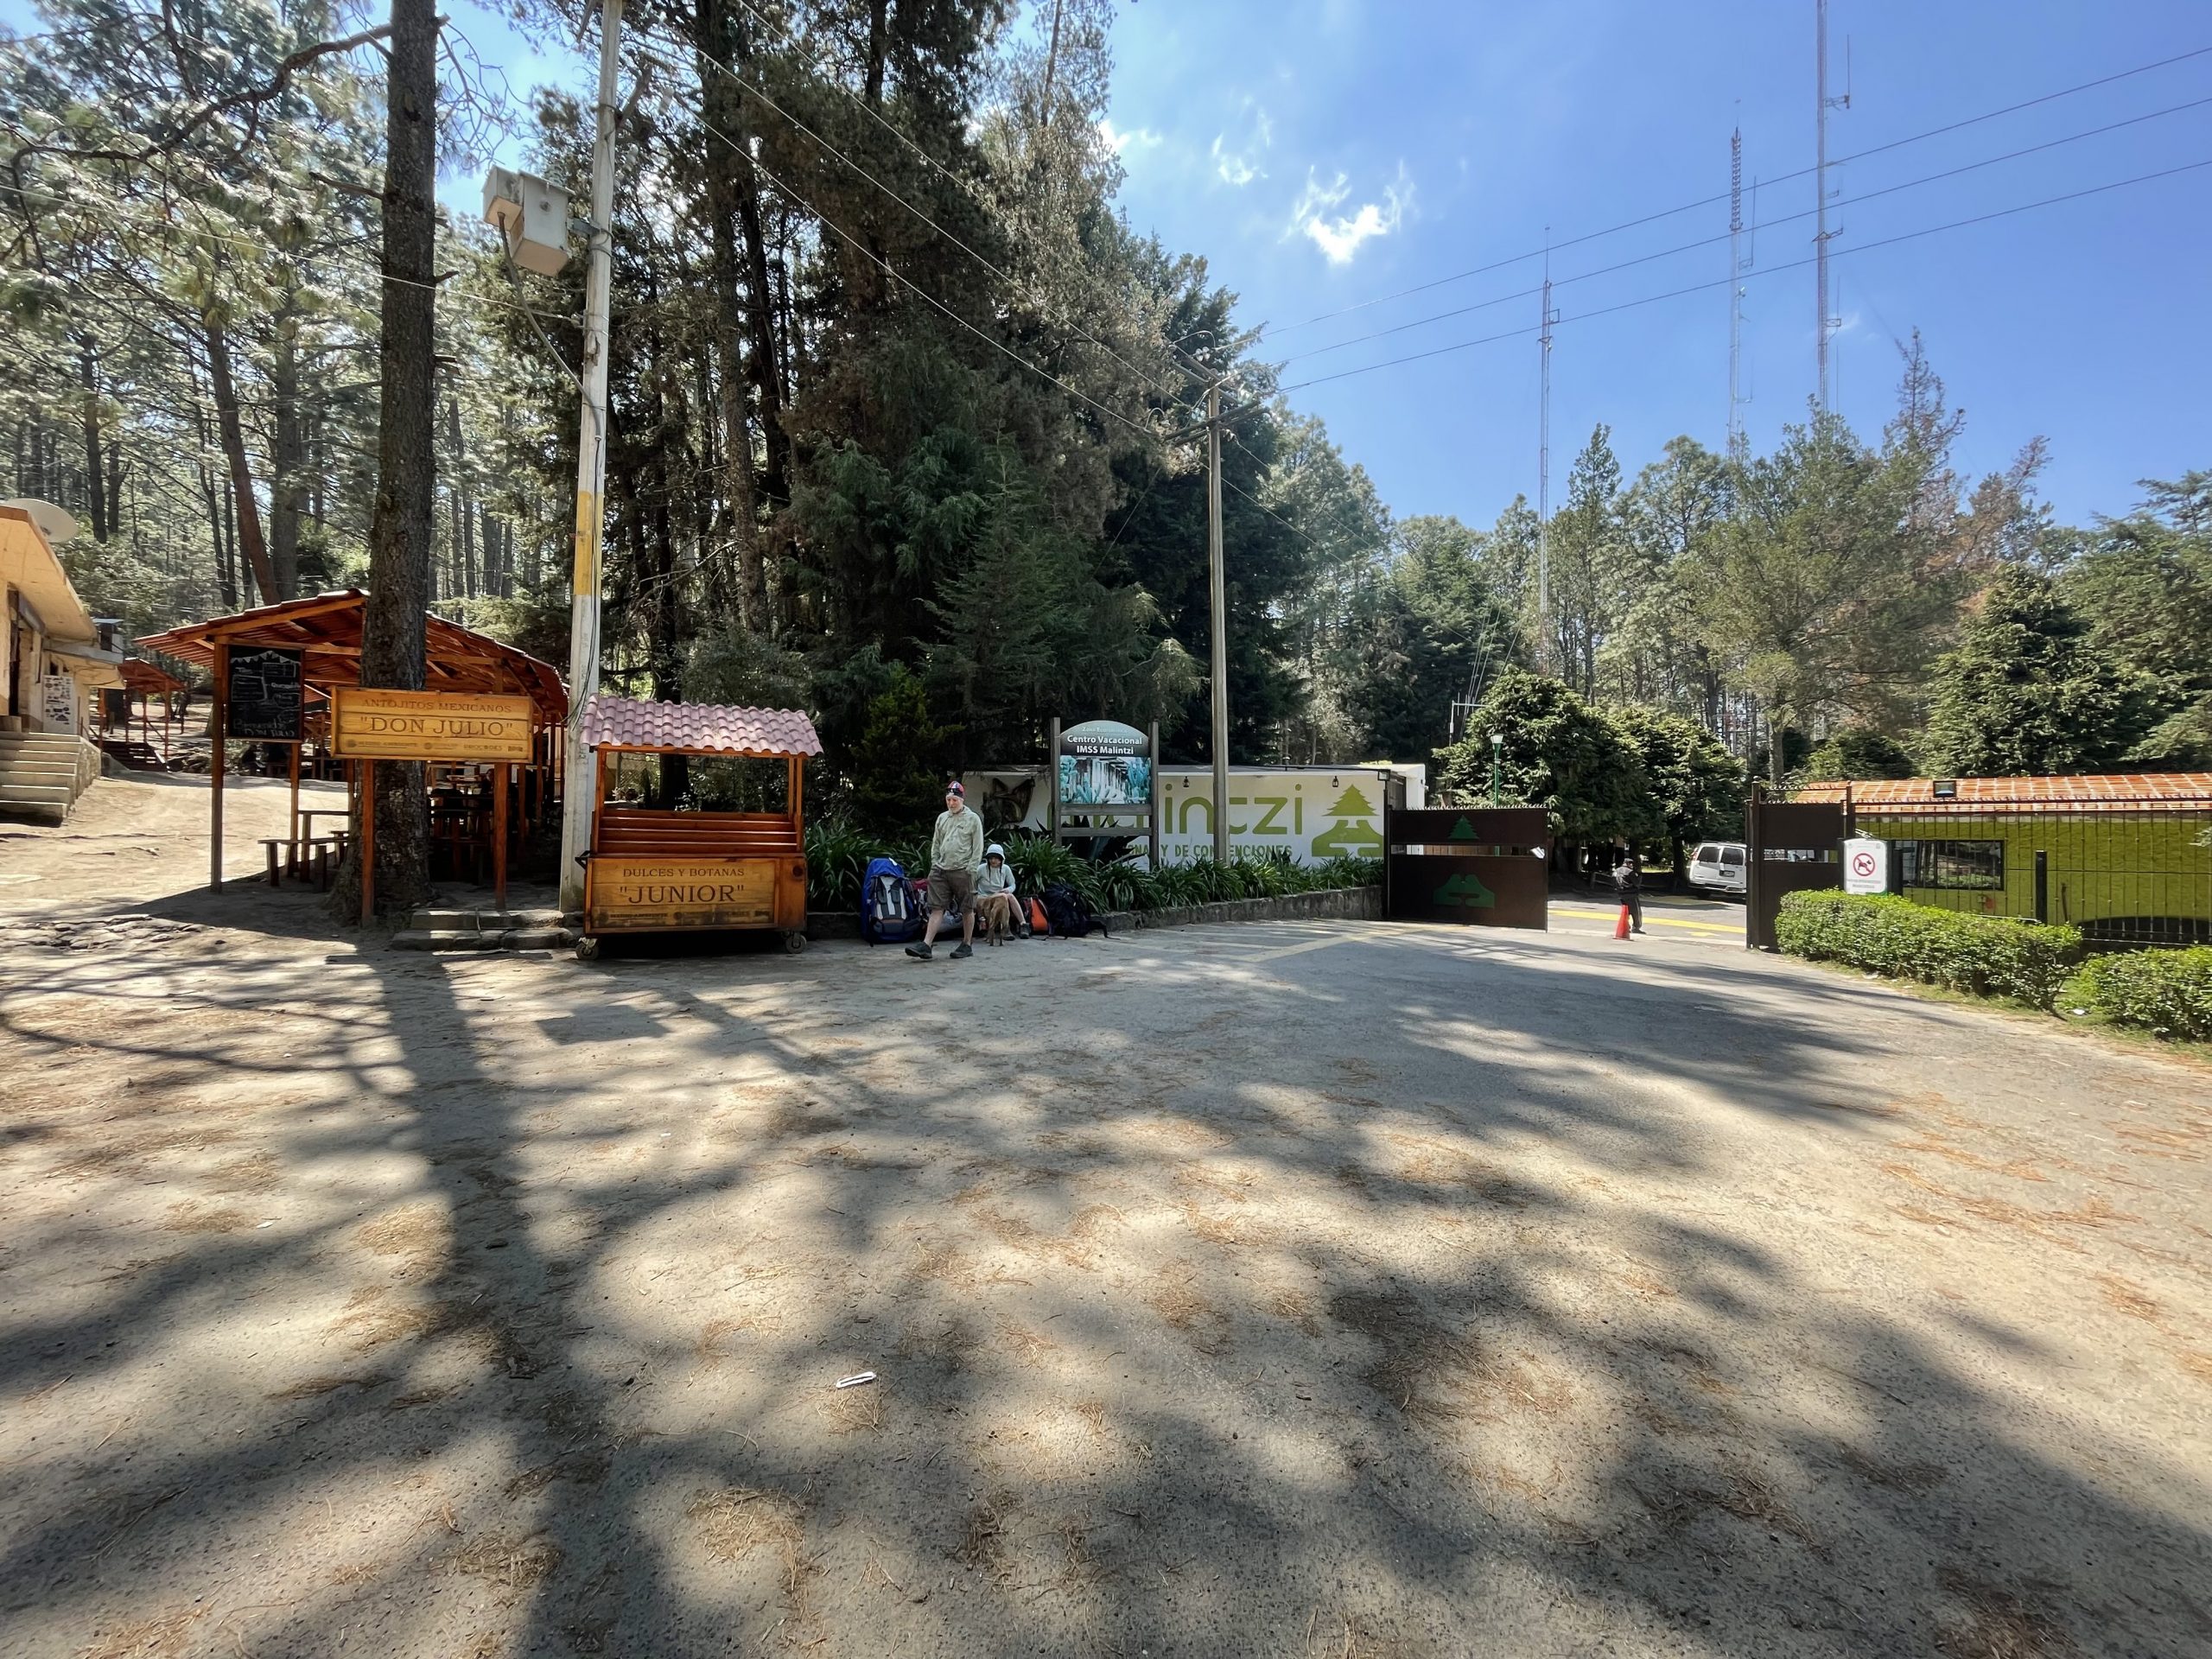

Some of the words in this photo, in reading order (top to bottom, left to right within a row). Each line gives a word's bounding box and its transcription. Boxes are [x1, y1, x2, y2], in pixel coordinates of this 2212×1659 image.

[363, 698, 433, 710] ANTOJITOS
[438, 702, 512, 713] MEXICANOS
[360, 716, 426, 734] "DON
[432, 719, 513, 736] JULIO"
[1066, 734, 1096, 744] Centro
[1097, 735, 1142, 745] Vacacional
[1077, 745, 1098, 753] IMSS
[1099, 746, 1135, 754] Malintzi
[1160, 844, 1169, 857] Y
[1174, 844, 1189, 857] DE
[623, 868, 675, 878] DULCES
[675, 868, 686, 877] Y
[690, 868, 745, 877] BOTANAS
[619, 884, 745, 905] "JUNIOR"
